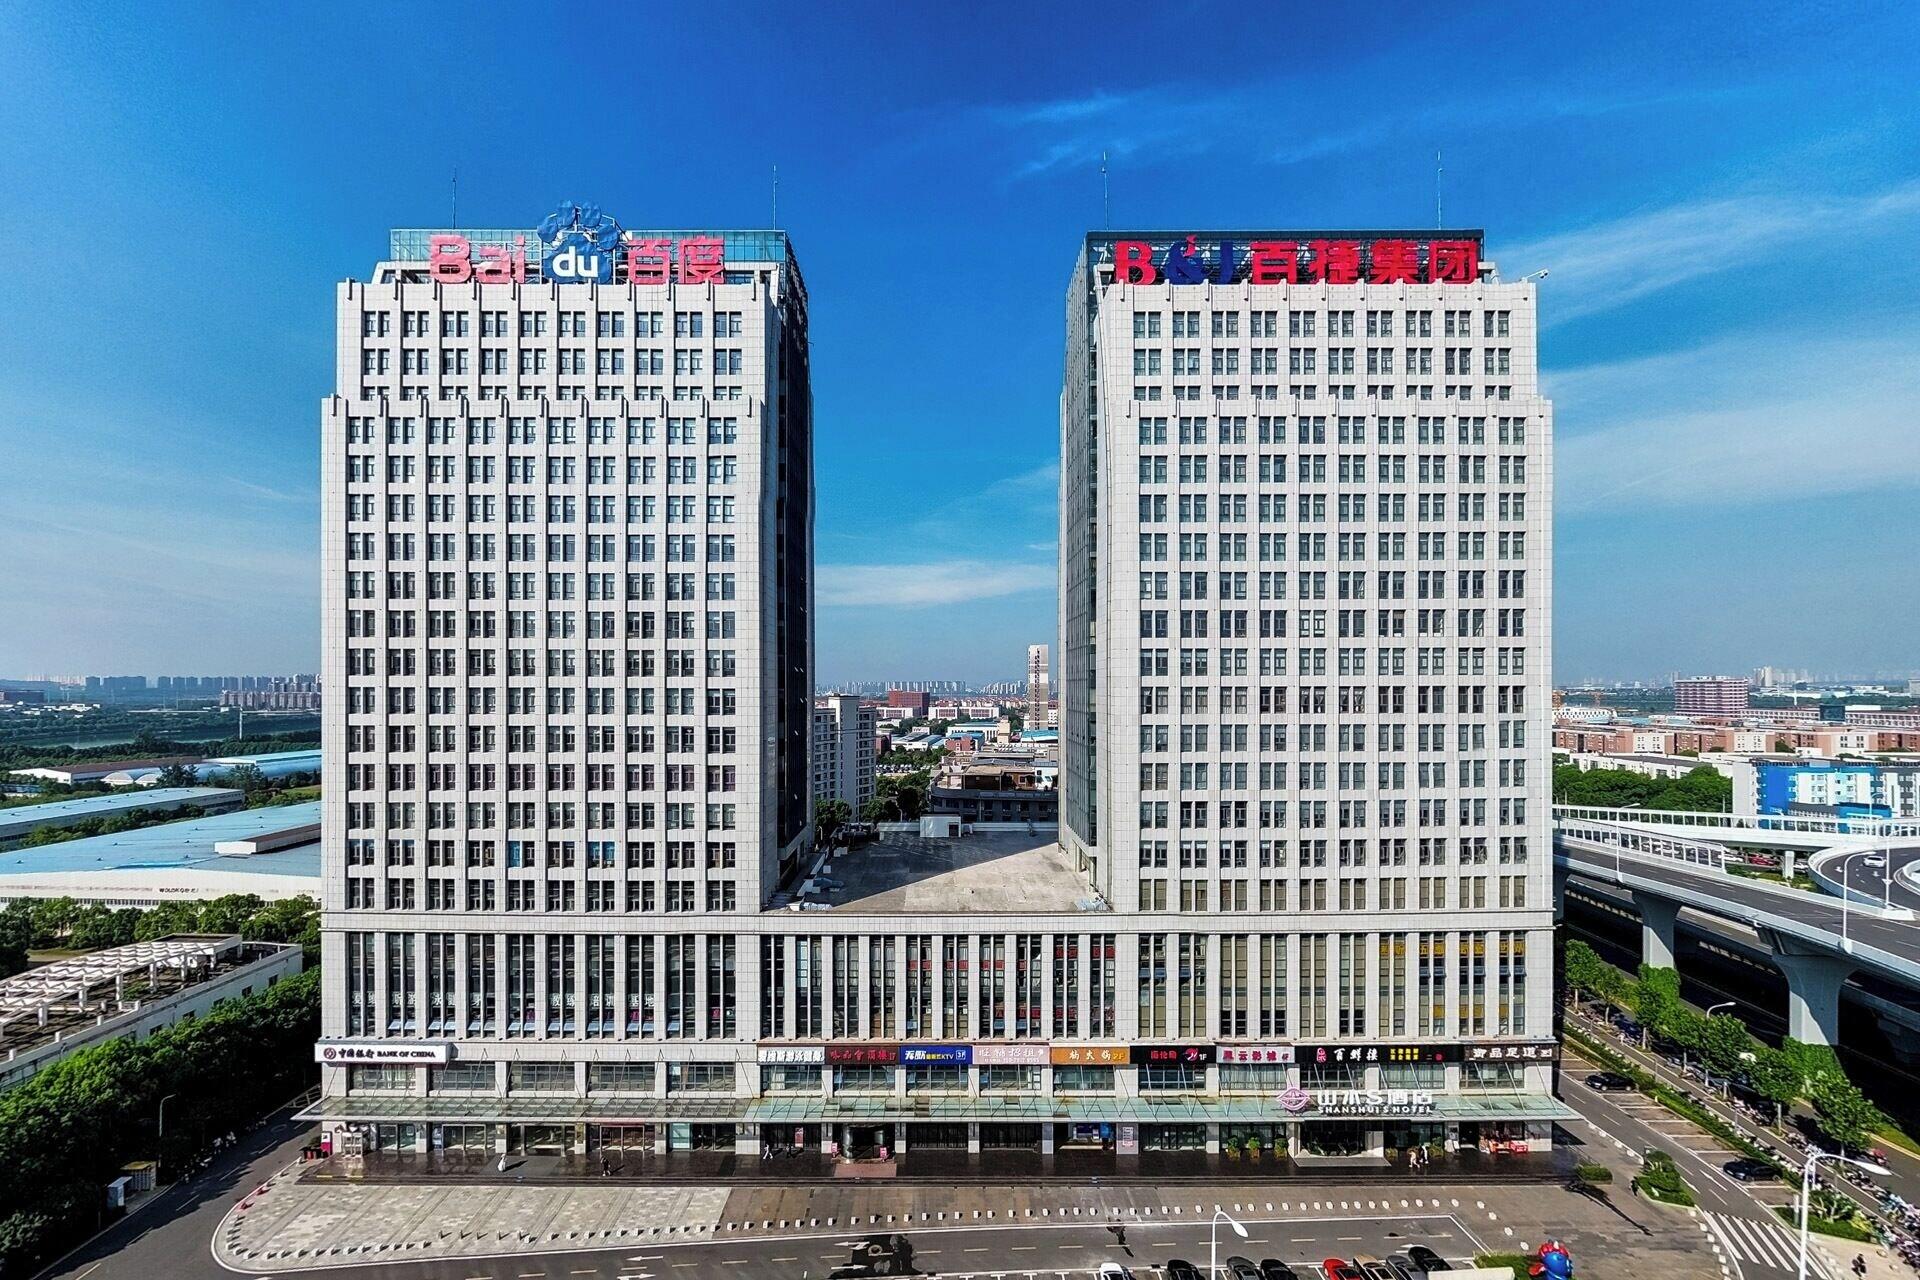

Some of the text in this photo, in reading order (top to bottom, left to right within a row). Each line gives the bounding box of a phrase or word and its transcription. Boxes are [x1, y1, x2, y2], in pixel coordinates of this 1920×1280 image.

[429, 234, 599, 284] Bai du
[628, 236, 725, 284] 百度
[1114, 236, 1234, 285] B&J
[1250, 239, 1478, 285] 百捷集团
[377, 1050, 398, 1058] BANK
[399, 1050, 408, 1058] OF
[410, 1050, 436, 1058] CHINA
[1317, 1088, 1433, 1105] 山水S酒店
[1317, 1105, 1380, 1114] SHANSHUI
[1391, 1105, 1433, 1114] HOTEL
